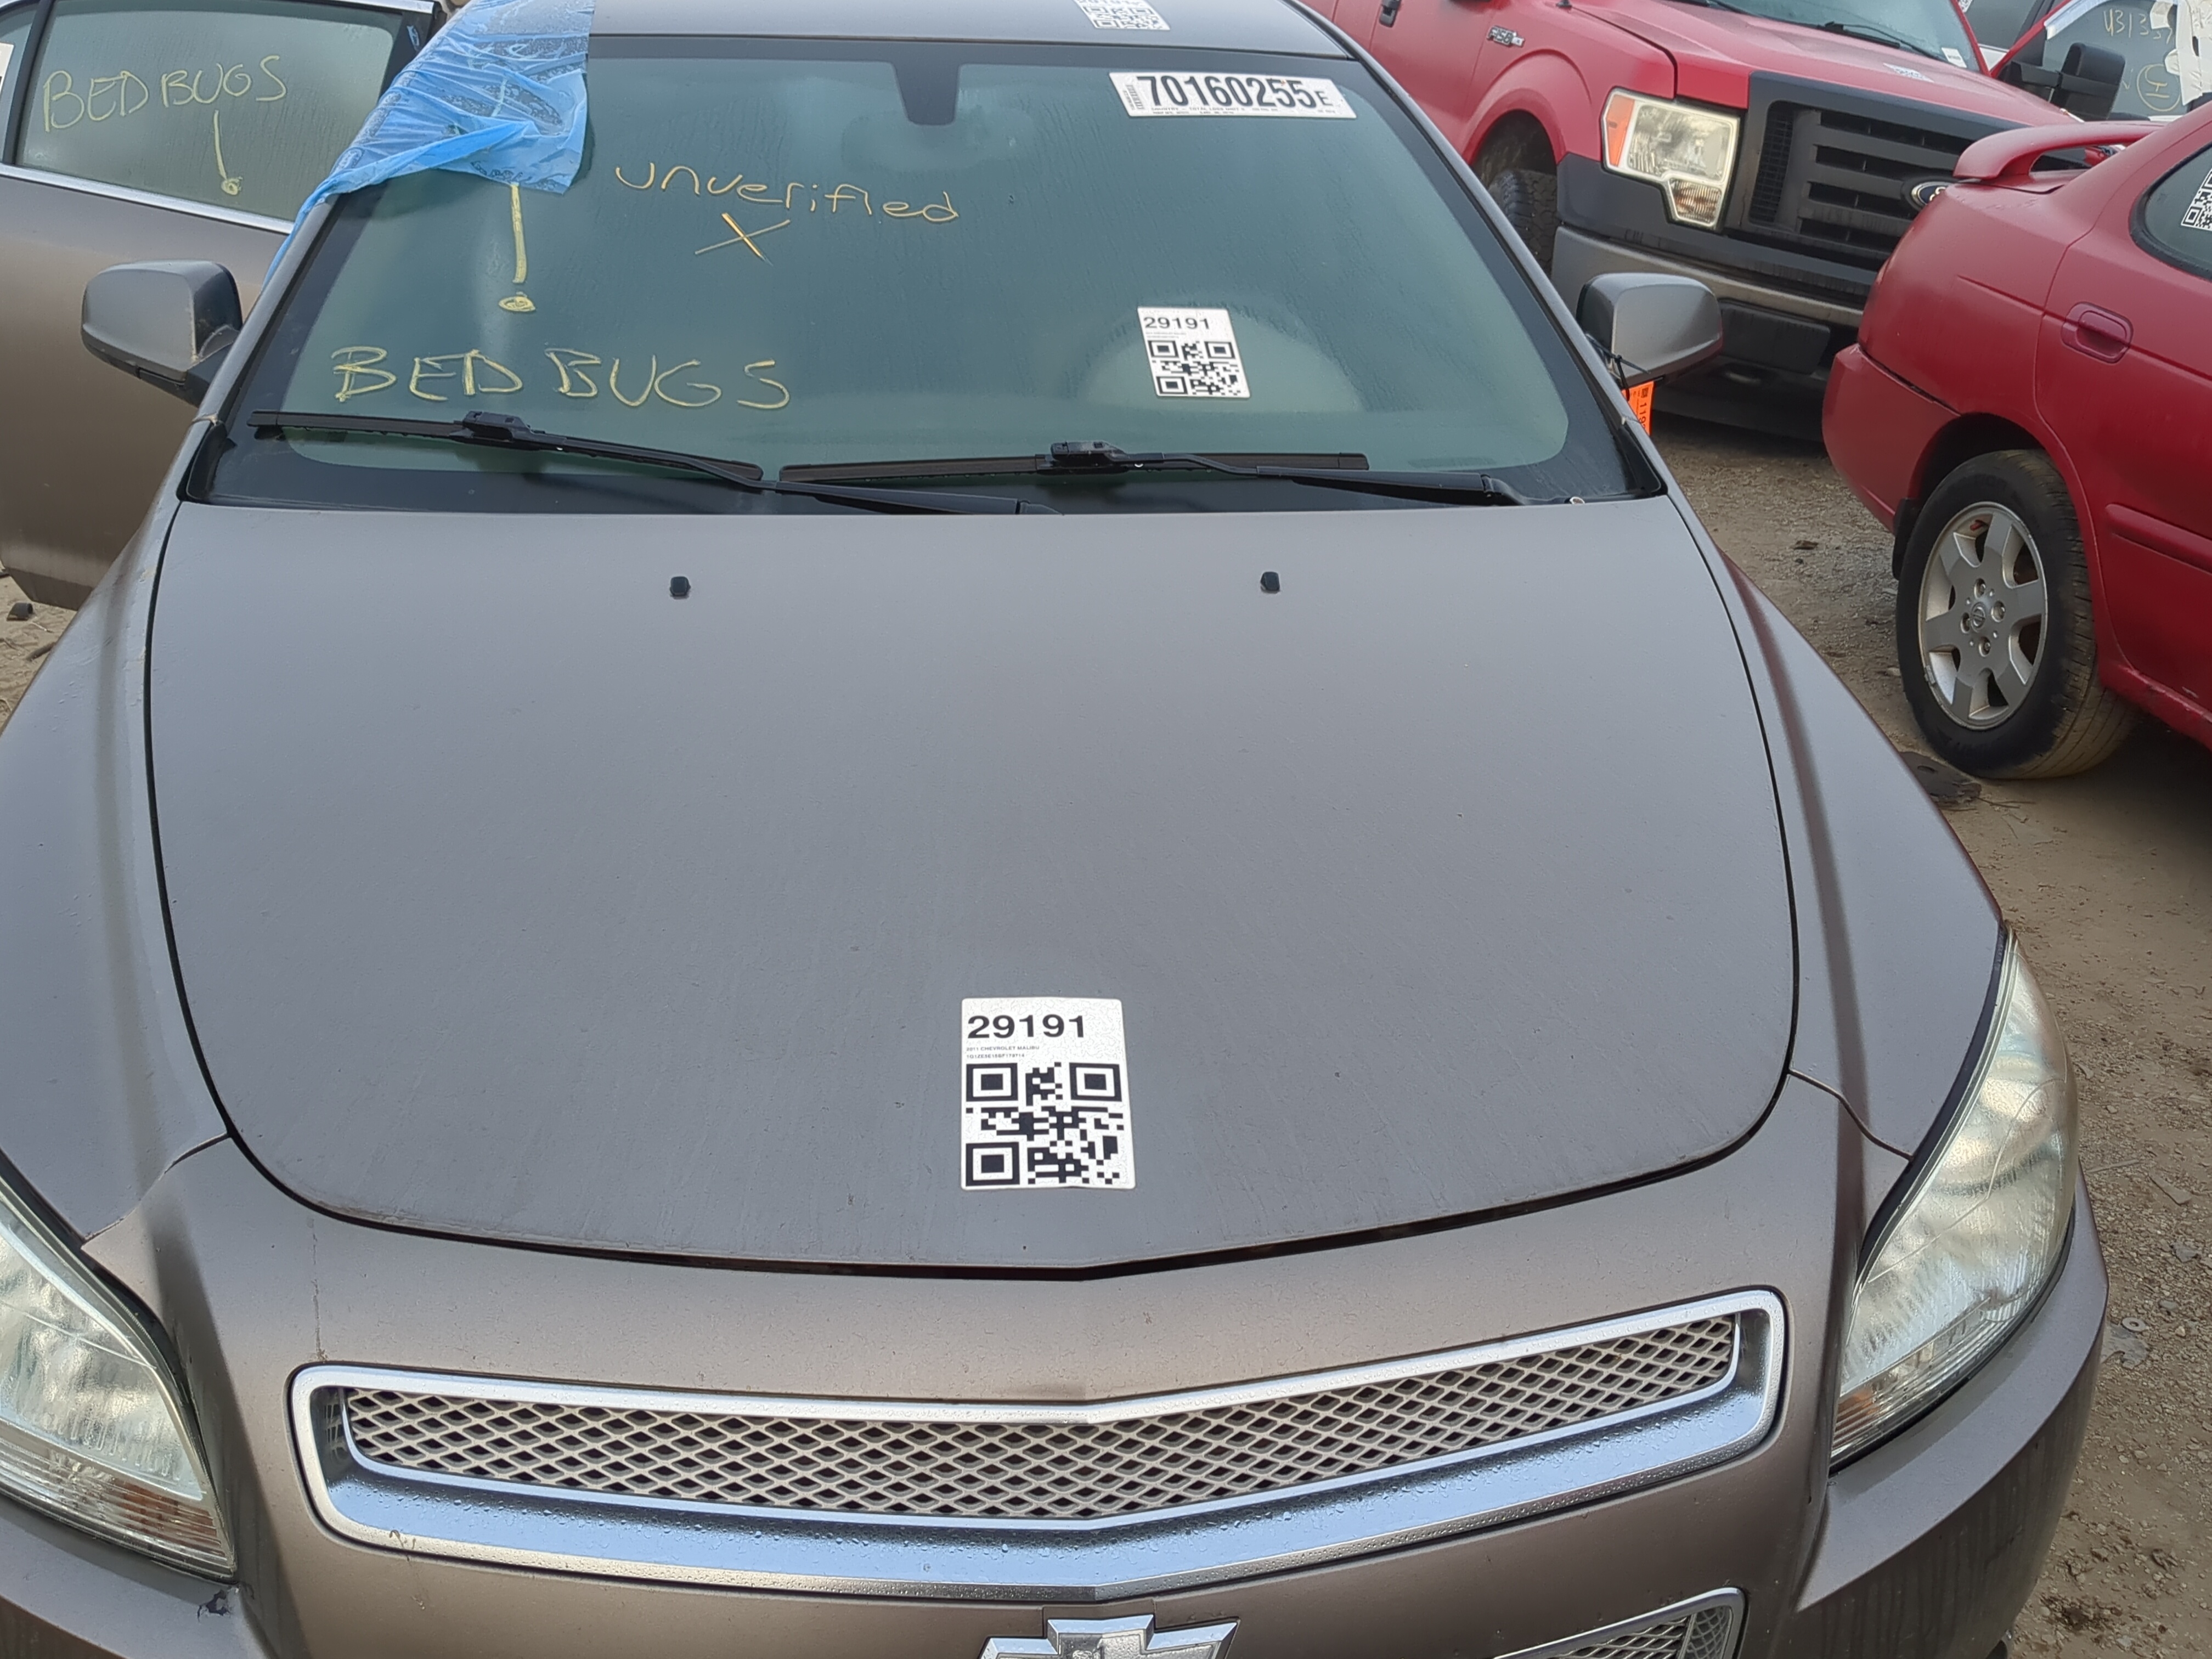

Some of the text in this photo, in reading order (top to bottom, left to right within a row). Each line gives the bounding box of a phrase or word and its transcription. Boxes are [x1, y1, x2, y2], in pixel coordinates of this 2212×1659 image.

[42, 55, 288, 133] BED BUGS
[1136, 75, 1317, 109] 70160255
[1144, 317, 1209, 329] 29191
[331, 346, 790, 409] BED BUGS
[967, 1014, 1084, 1039] 29191
